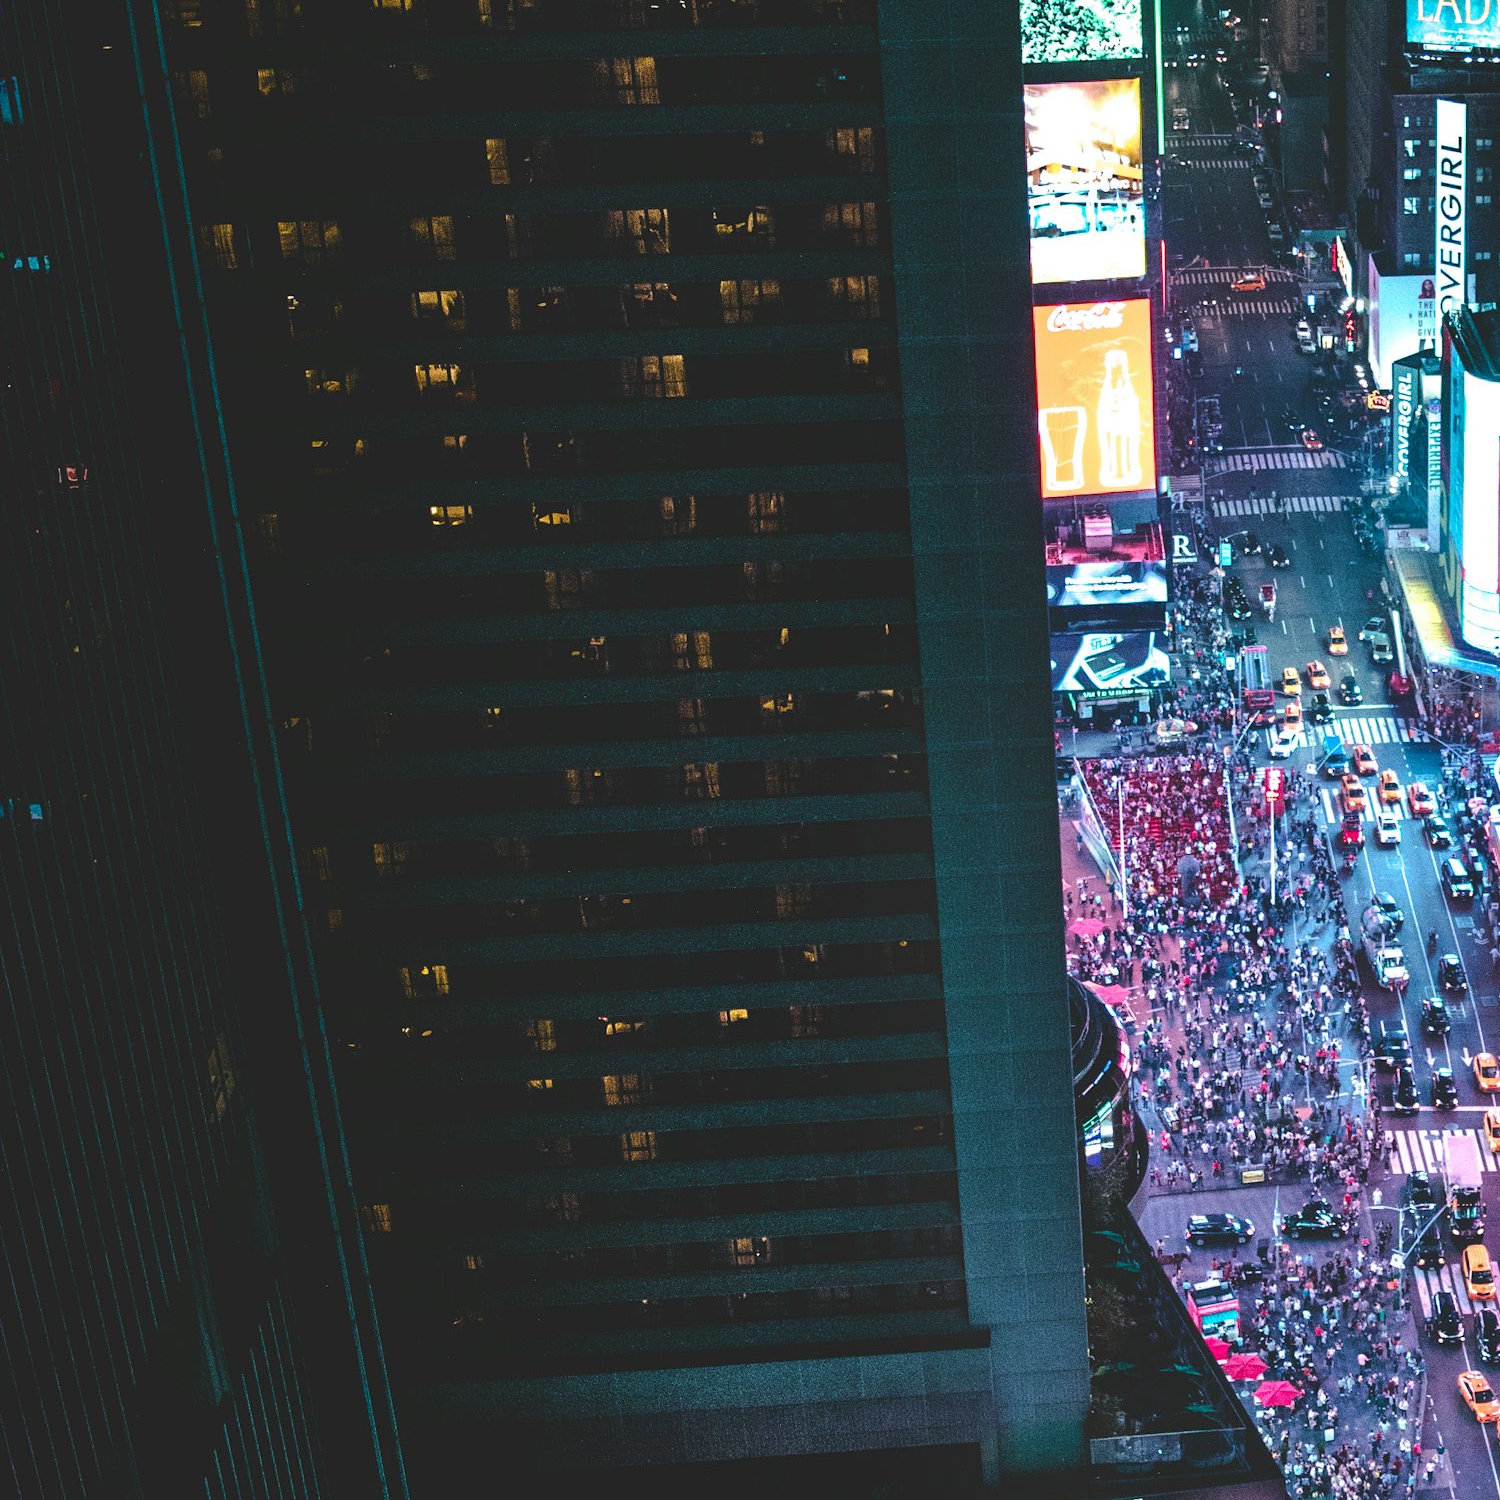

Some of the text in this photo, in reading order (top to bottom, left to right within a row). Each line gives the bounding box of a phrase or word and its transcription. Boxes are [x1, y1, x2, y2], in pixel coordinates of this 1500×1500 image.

[1440, 136, 1463, 326] OVERGIRL
[1418, 301, 1433, 309] THE
[1418, 320, 1423, 328] U
[1172, 535, 1196, 557] R
